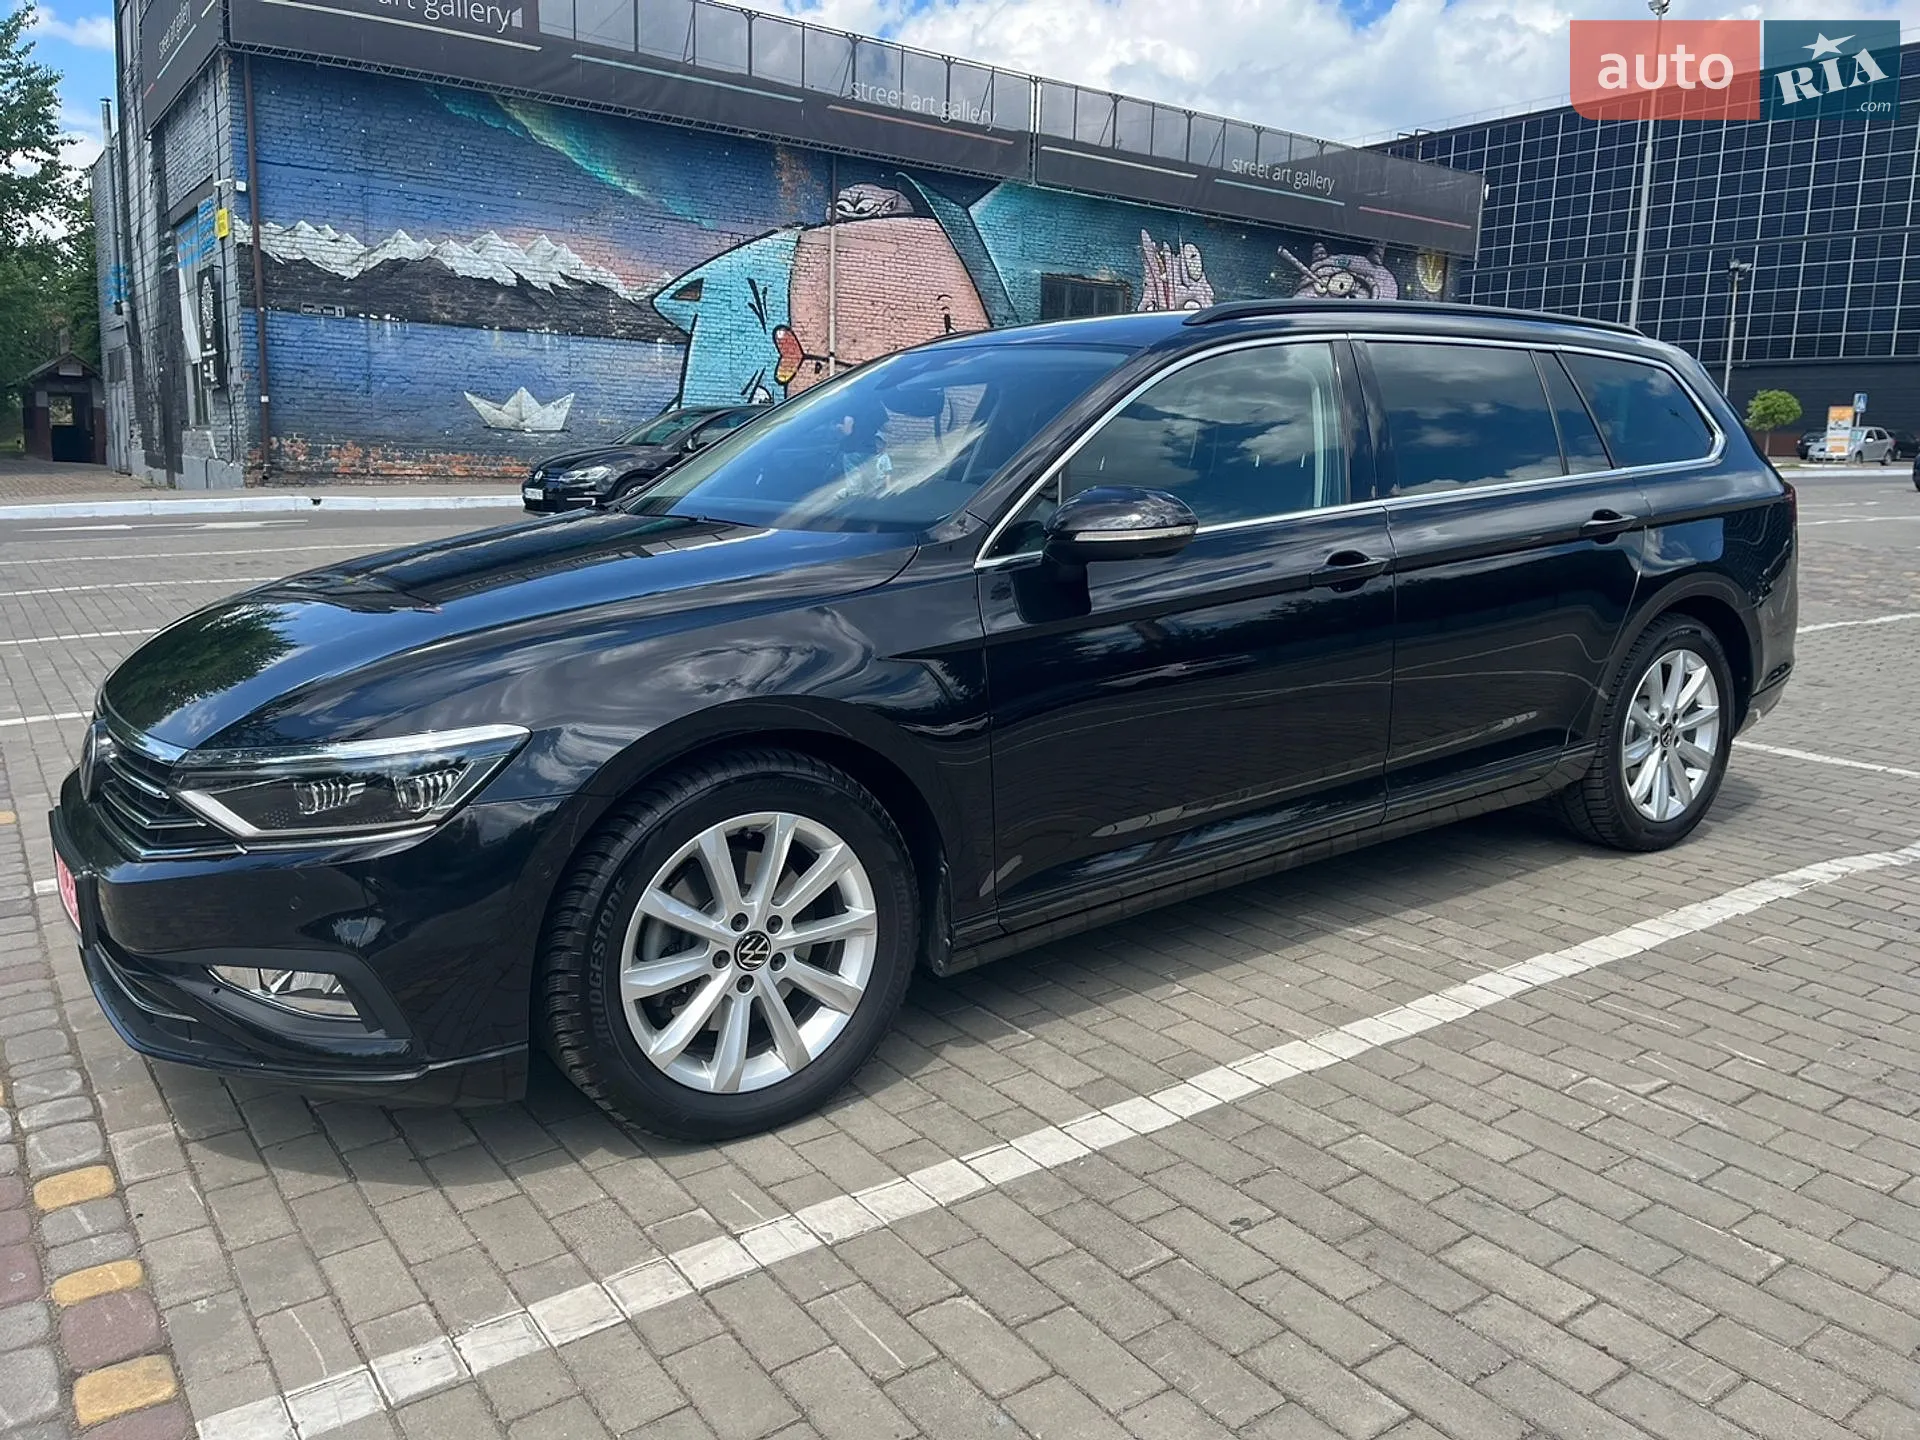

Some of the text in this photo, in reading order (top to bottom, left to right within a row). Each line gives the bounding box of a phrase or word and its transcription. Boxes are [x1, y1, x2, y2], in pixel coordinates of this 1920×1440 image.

[424, 0, 511, 33] gallery
[850, 81, 997, 132] street art gallery
[1231, 159, 1335, 196] street art gallery
